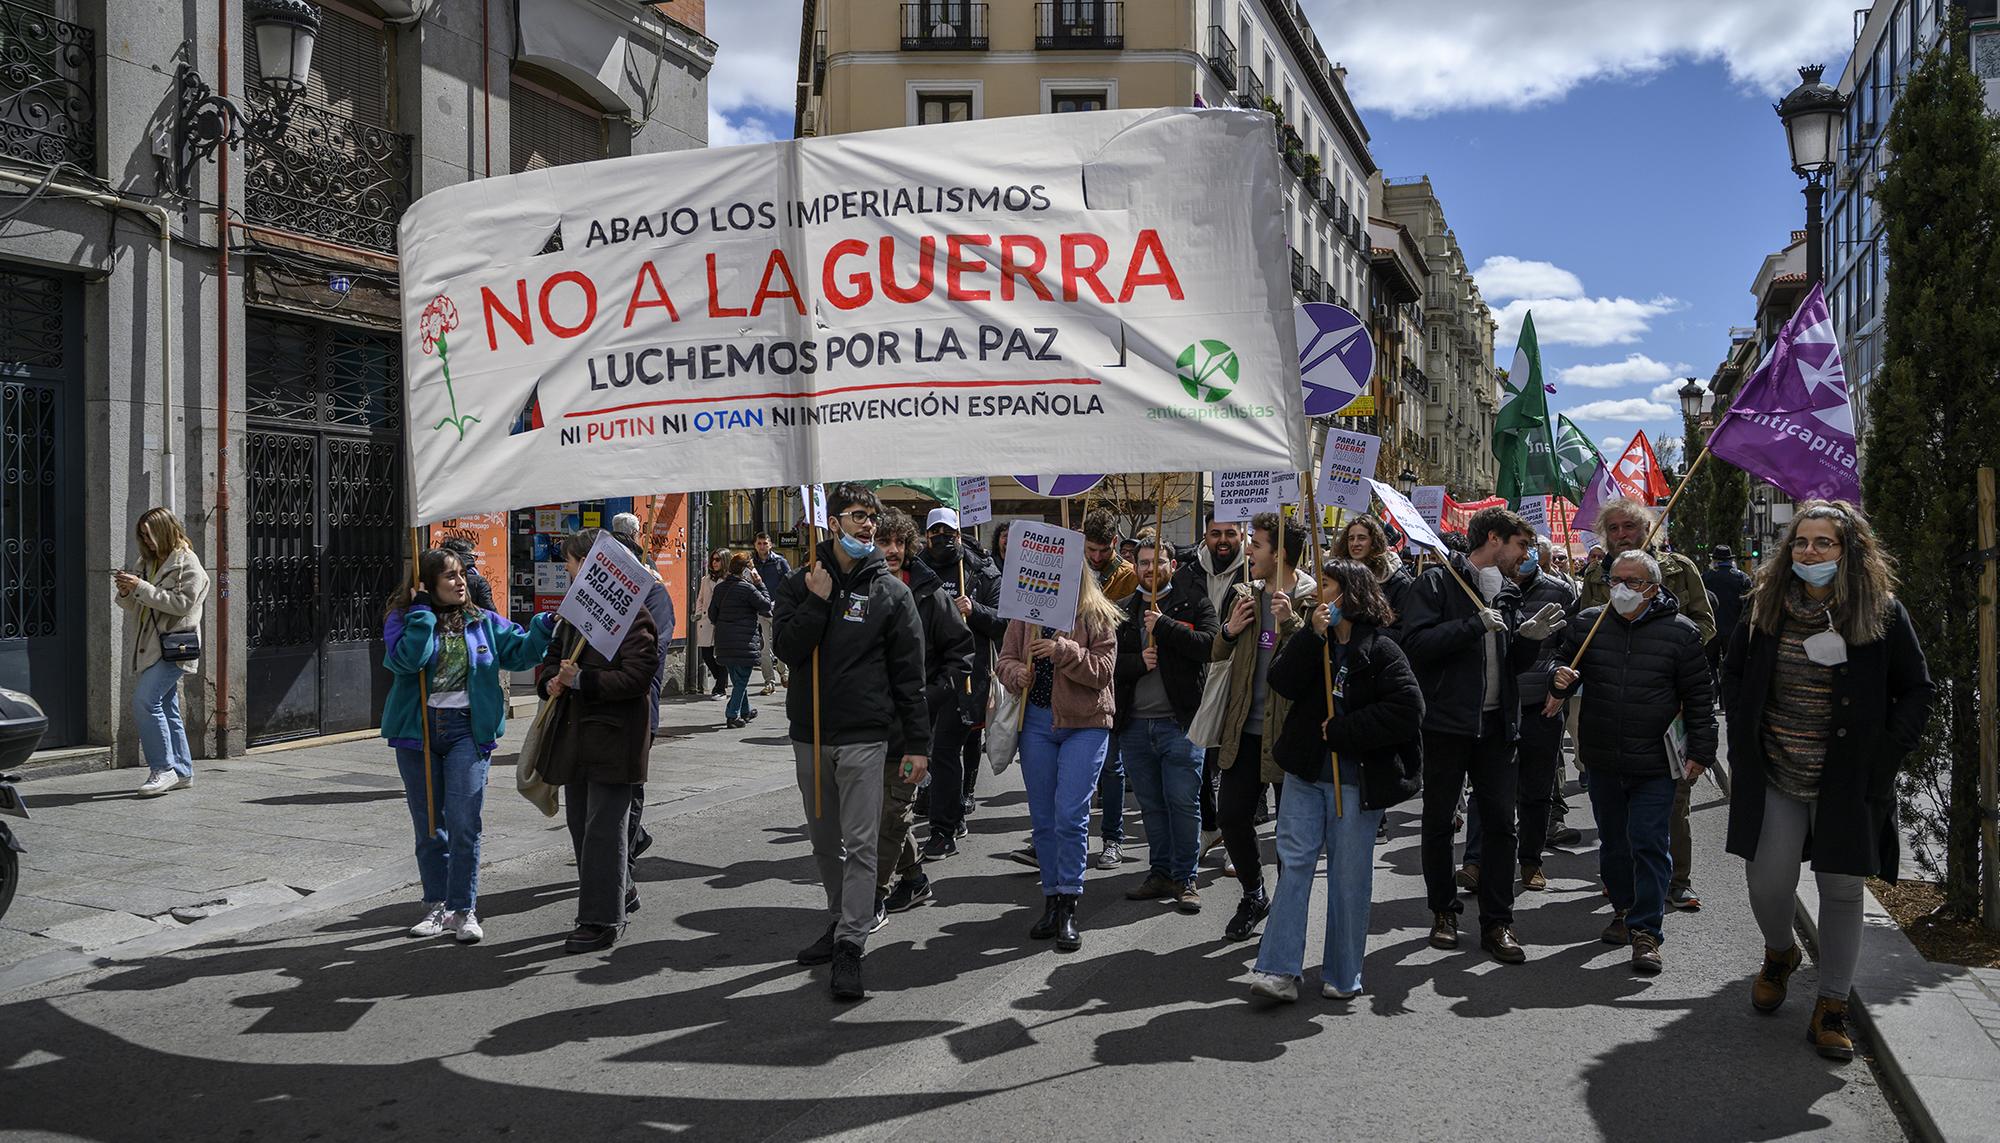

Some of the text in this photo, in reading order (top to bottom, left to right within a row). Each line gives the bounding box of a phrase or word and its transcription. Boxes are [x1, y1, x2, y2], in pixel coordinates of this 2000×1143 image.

[586, 185, 1051, 248] ABAJO LOS IMPERIALISMOS
[480, 229, 1185, 351] NO A LA GUERRA
[588, 324, 1062, 391] LUCHEMOS POR LA PAZ
[560, 389, 1105, 446] NI PUTIN NI OTAN NI INTERVENCIÓN ESPAÑOLA
[1146, 404, 1275, 423] anticapitalistas
[1335, 443, 1366, 454] GUERRA
[1336, 436, 1367, 447] PARA LA
[1740, 412, 1857, 473] anticapita
[1221, 470, 1270, 480] AUMENTAR
[1329, 470, 1361, 486] VIDA
[1331, 463, 1362, 475] PARA LA
[1220, 479, 1270, 488] LOS SALARIOS
[1021, 540, 1065, 555] GUERRA
[1023, 530, 1065, 546] PARA LA
[1019, 548, 1064, 569] NADA
[595, 551, 641, 595] GUERRAS
[1019, 566, 1061, 582] PARA LA
[584, 572, 629, 616] PAGAMOS
[588, 562, 633, 608] NO LAS
[1017, 575, 1060, 596] VIDA
[577, 588, 617, 626] BASTA DE
[1016, 589, 1057, 609] TODO
[575, 595, 593, 613] GASTO
[591, 610, 613, 633] MILITAR
